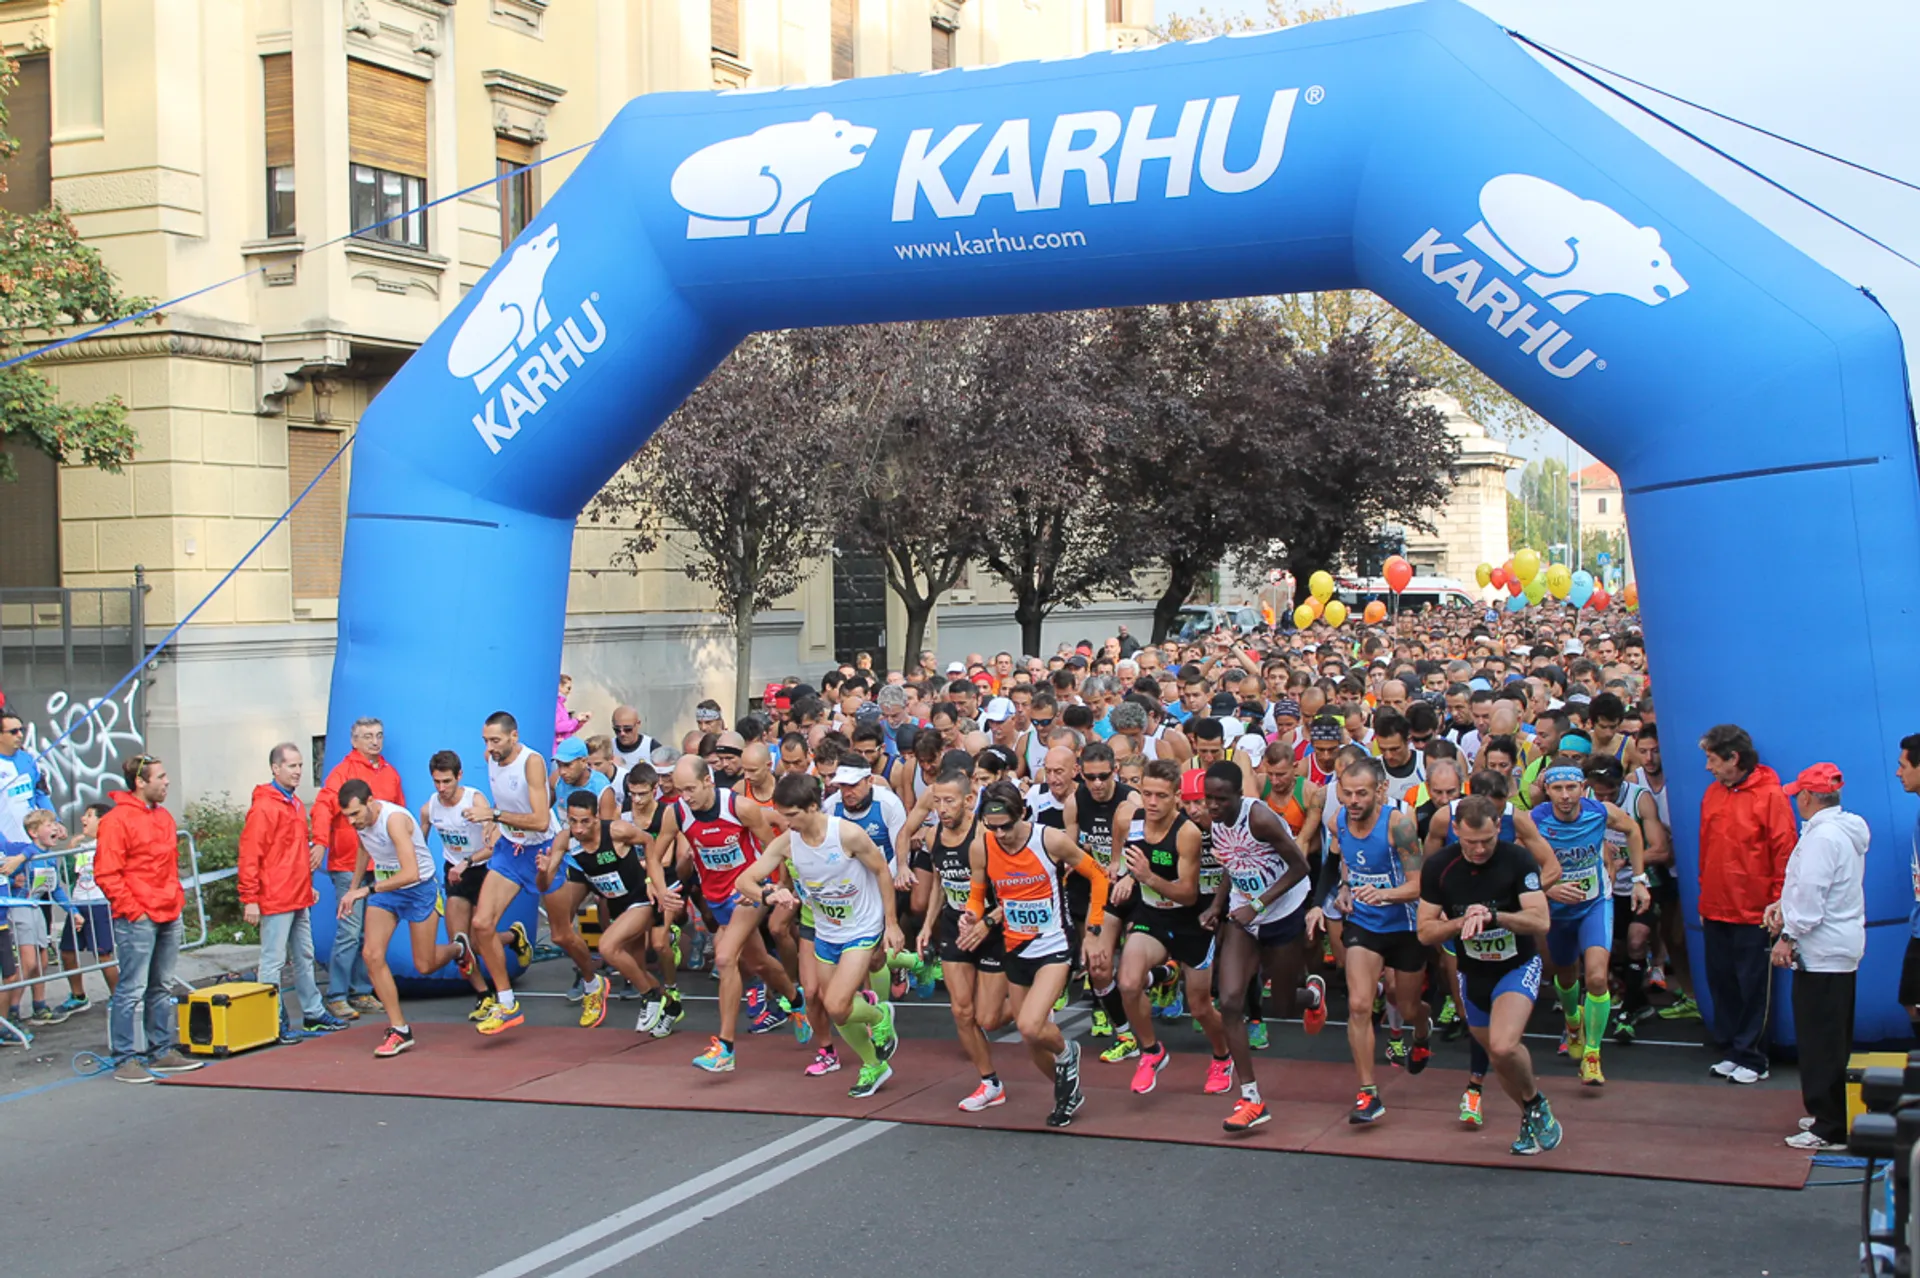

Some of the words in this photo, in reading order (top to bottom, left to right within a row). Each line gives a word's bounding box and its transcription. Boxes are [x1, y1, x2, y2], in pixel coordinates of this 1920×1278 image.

[891, 87, 1300, 222] KARHU
[894, 227, 1087, 260] www.karhu.com
[1401, 227, 1598, 379] KARHU
[471, 298, 608, 455] KARHU
[704, 847, 738, 864] 1607
[819, 904, 846, 919] 102
[1009, 909, 1049, 925] 1503
[1473, 938, 1506, 952] 370
